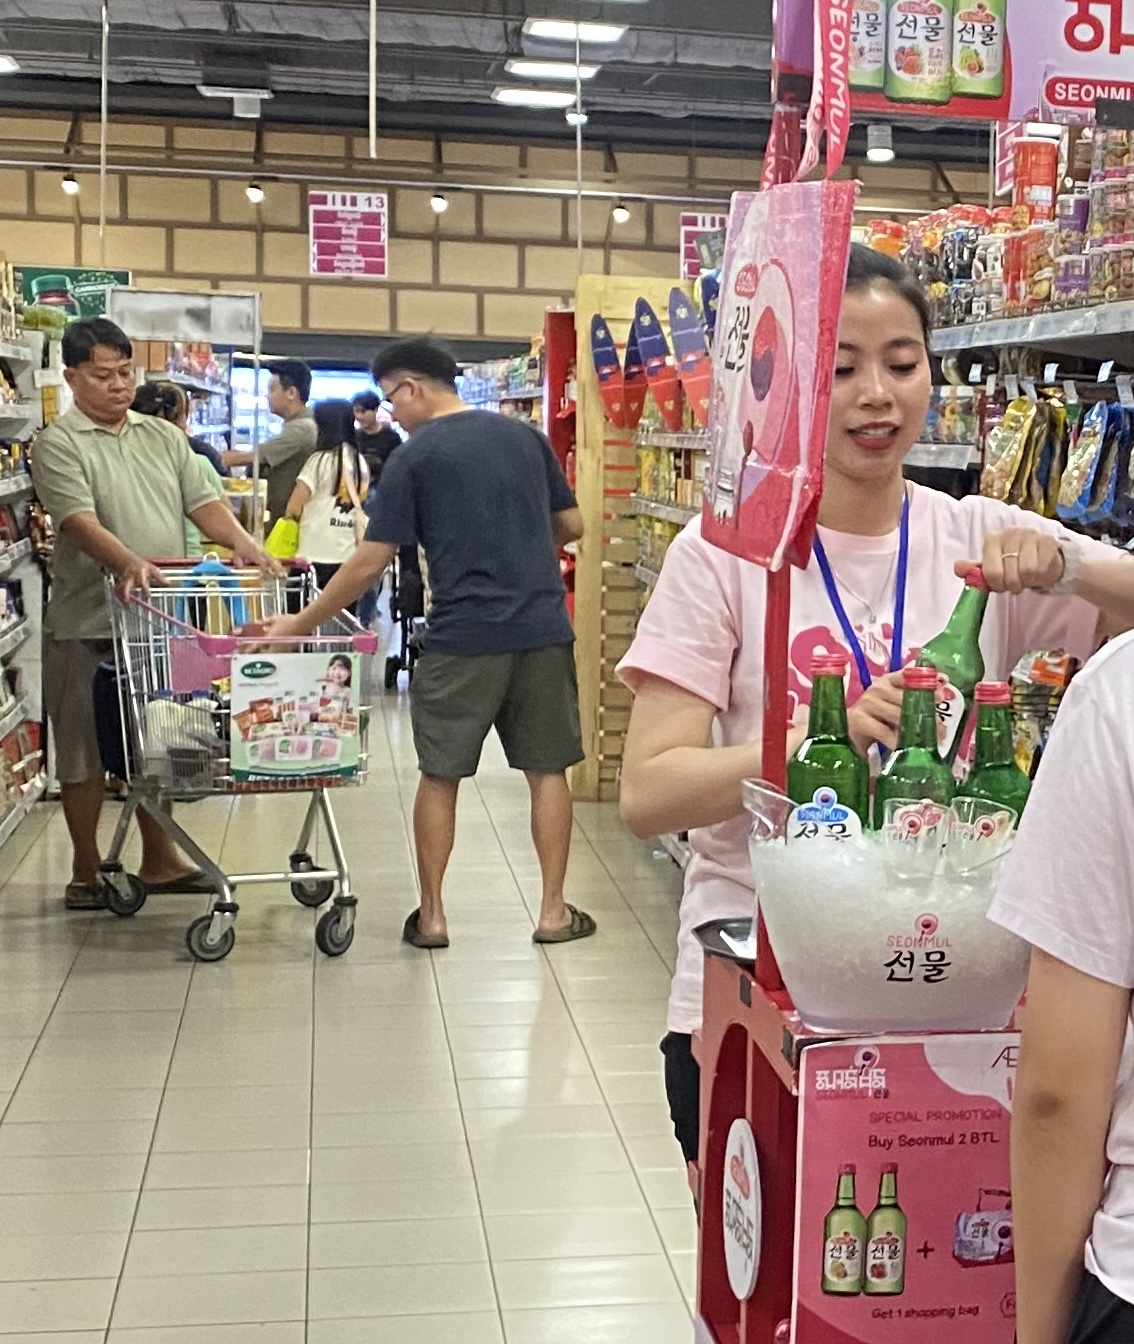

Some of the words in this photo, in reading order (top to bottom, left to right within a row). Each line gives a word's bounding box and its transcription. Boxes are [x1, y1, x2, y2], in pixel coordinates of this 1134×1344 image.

[365, 196, 384, 208] 13
[886, 935, 953, 948] SEONMUL
[869, 1111, 922, 1124] SPECIAL
[926, 1108, 1003, 1121] PROMOTION
[868, 1134, 894, 1150] Buy
[899, 1134, 954, 1147] Seonmul
[958, 1133, 966, 1145] 2
[970, 1131, 999, 1144] BTL
[872, 1308, 893, 1319] Get
[905, 1306, 955, 1319] shopping
[959, 1306, 980, 1317] bag
